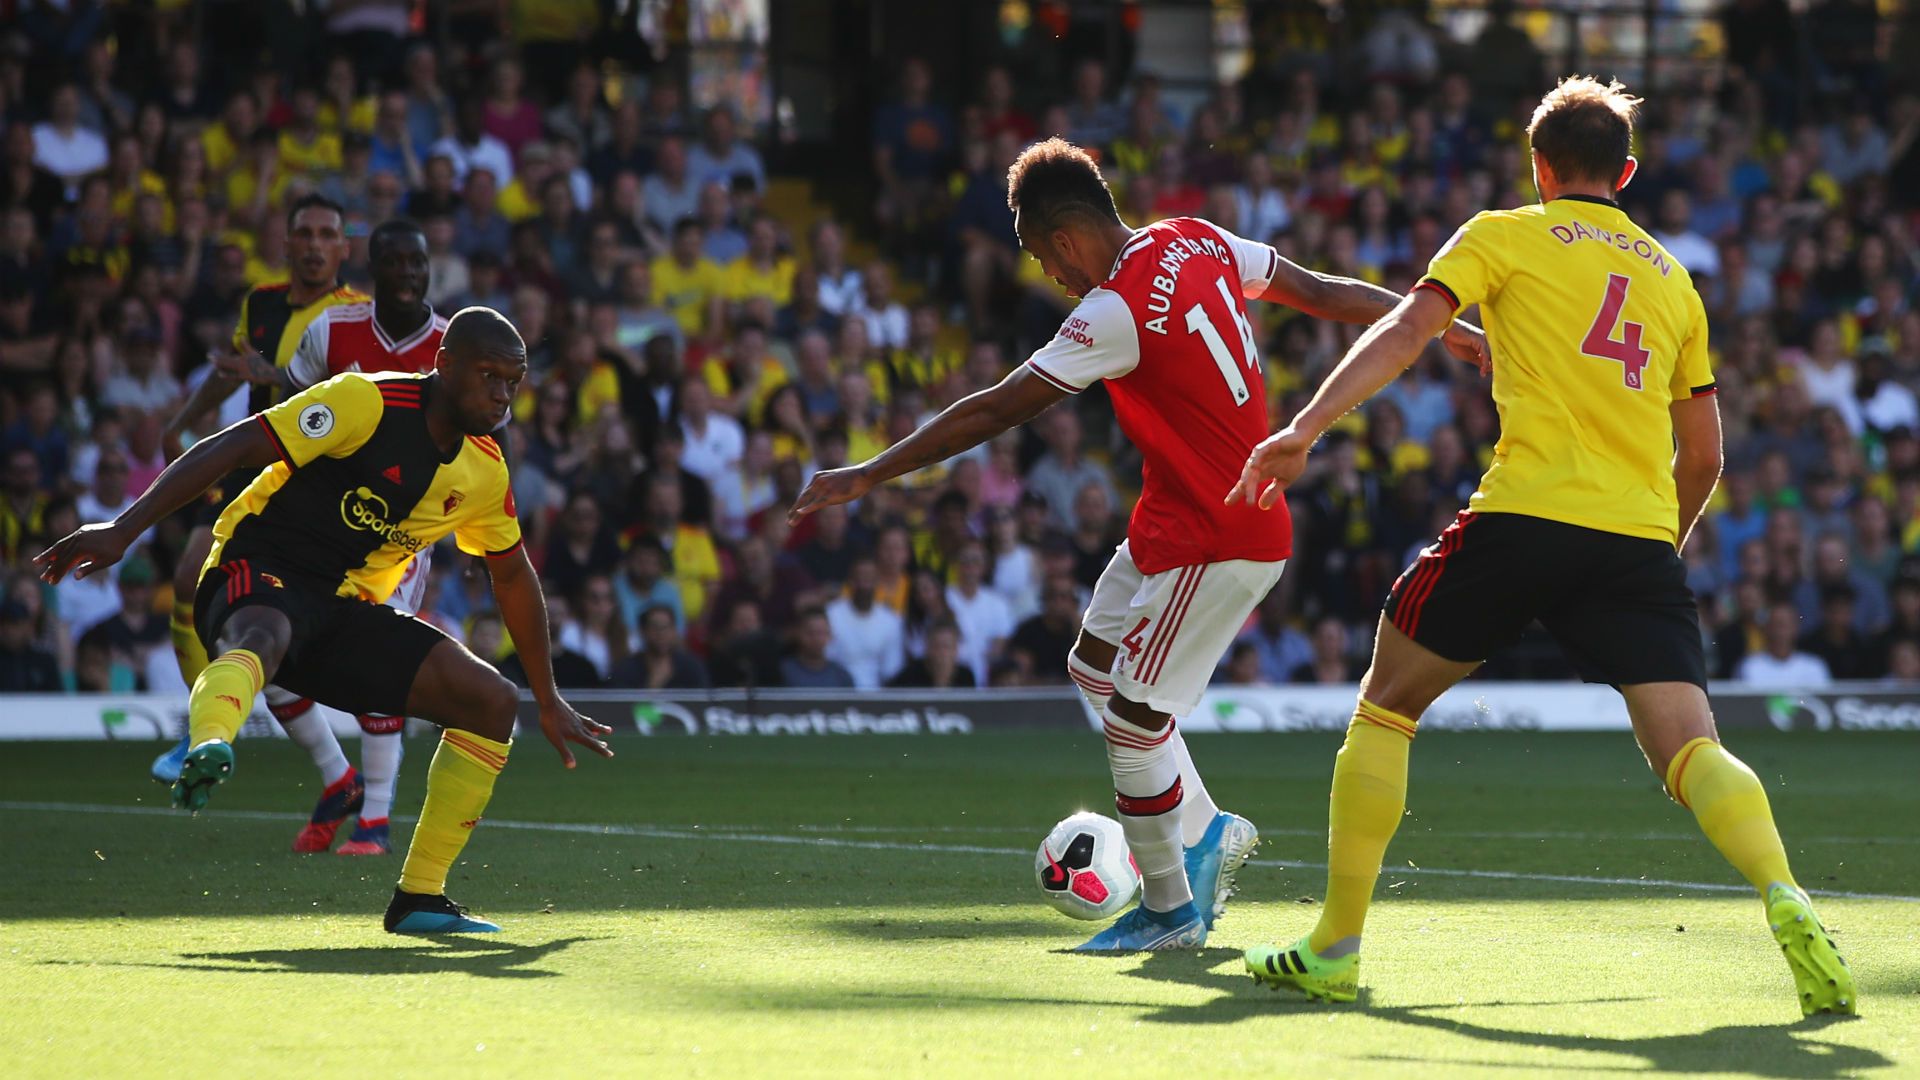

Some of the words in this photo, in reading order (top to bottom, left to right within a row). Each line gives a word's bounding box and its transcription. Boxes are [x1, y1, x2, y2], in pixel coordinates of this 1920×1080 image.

[1549, 220, 1672, 278] DAWSON
[1184, 275, 1262, 407] 14
[1579, 271, 1652, 392] 4
